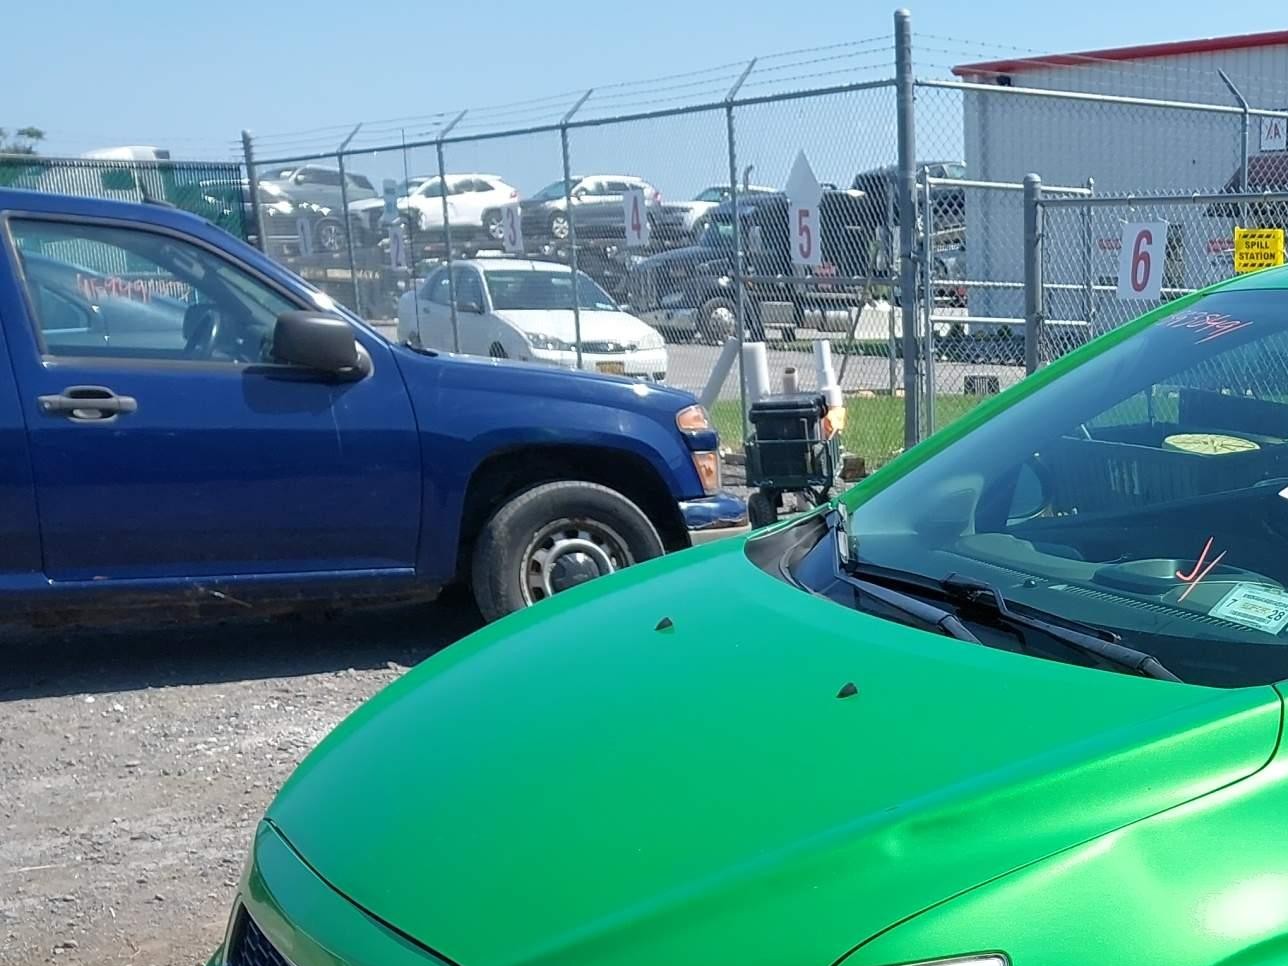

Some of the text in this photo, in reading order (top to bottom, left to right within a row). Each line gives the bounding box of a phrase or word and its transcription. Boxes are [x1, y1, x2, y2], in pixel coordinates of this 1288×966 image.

[506, 207, 518, 246] 3
[631, 196, 642, 240] 4
[798, 208, 812, 259] 5
[1130, 229, 1153, 292] 6
[1238, 252, 1276, 261] STATION
[1244, 240, 1270, 249] SPILL
[1266, 609, 1286, 622] 28
